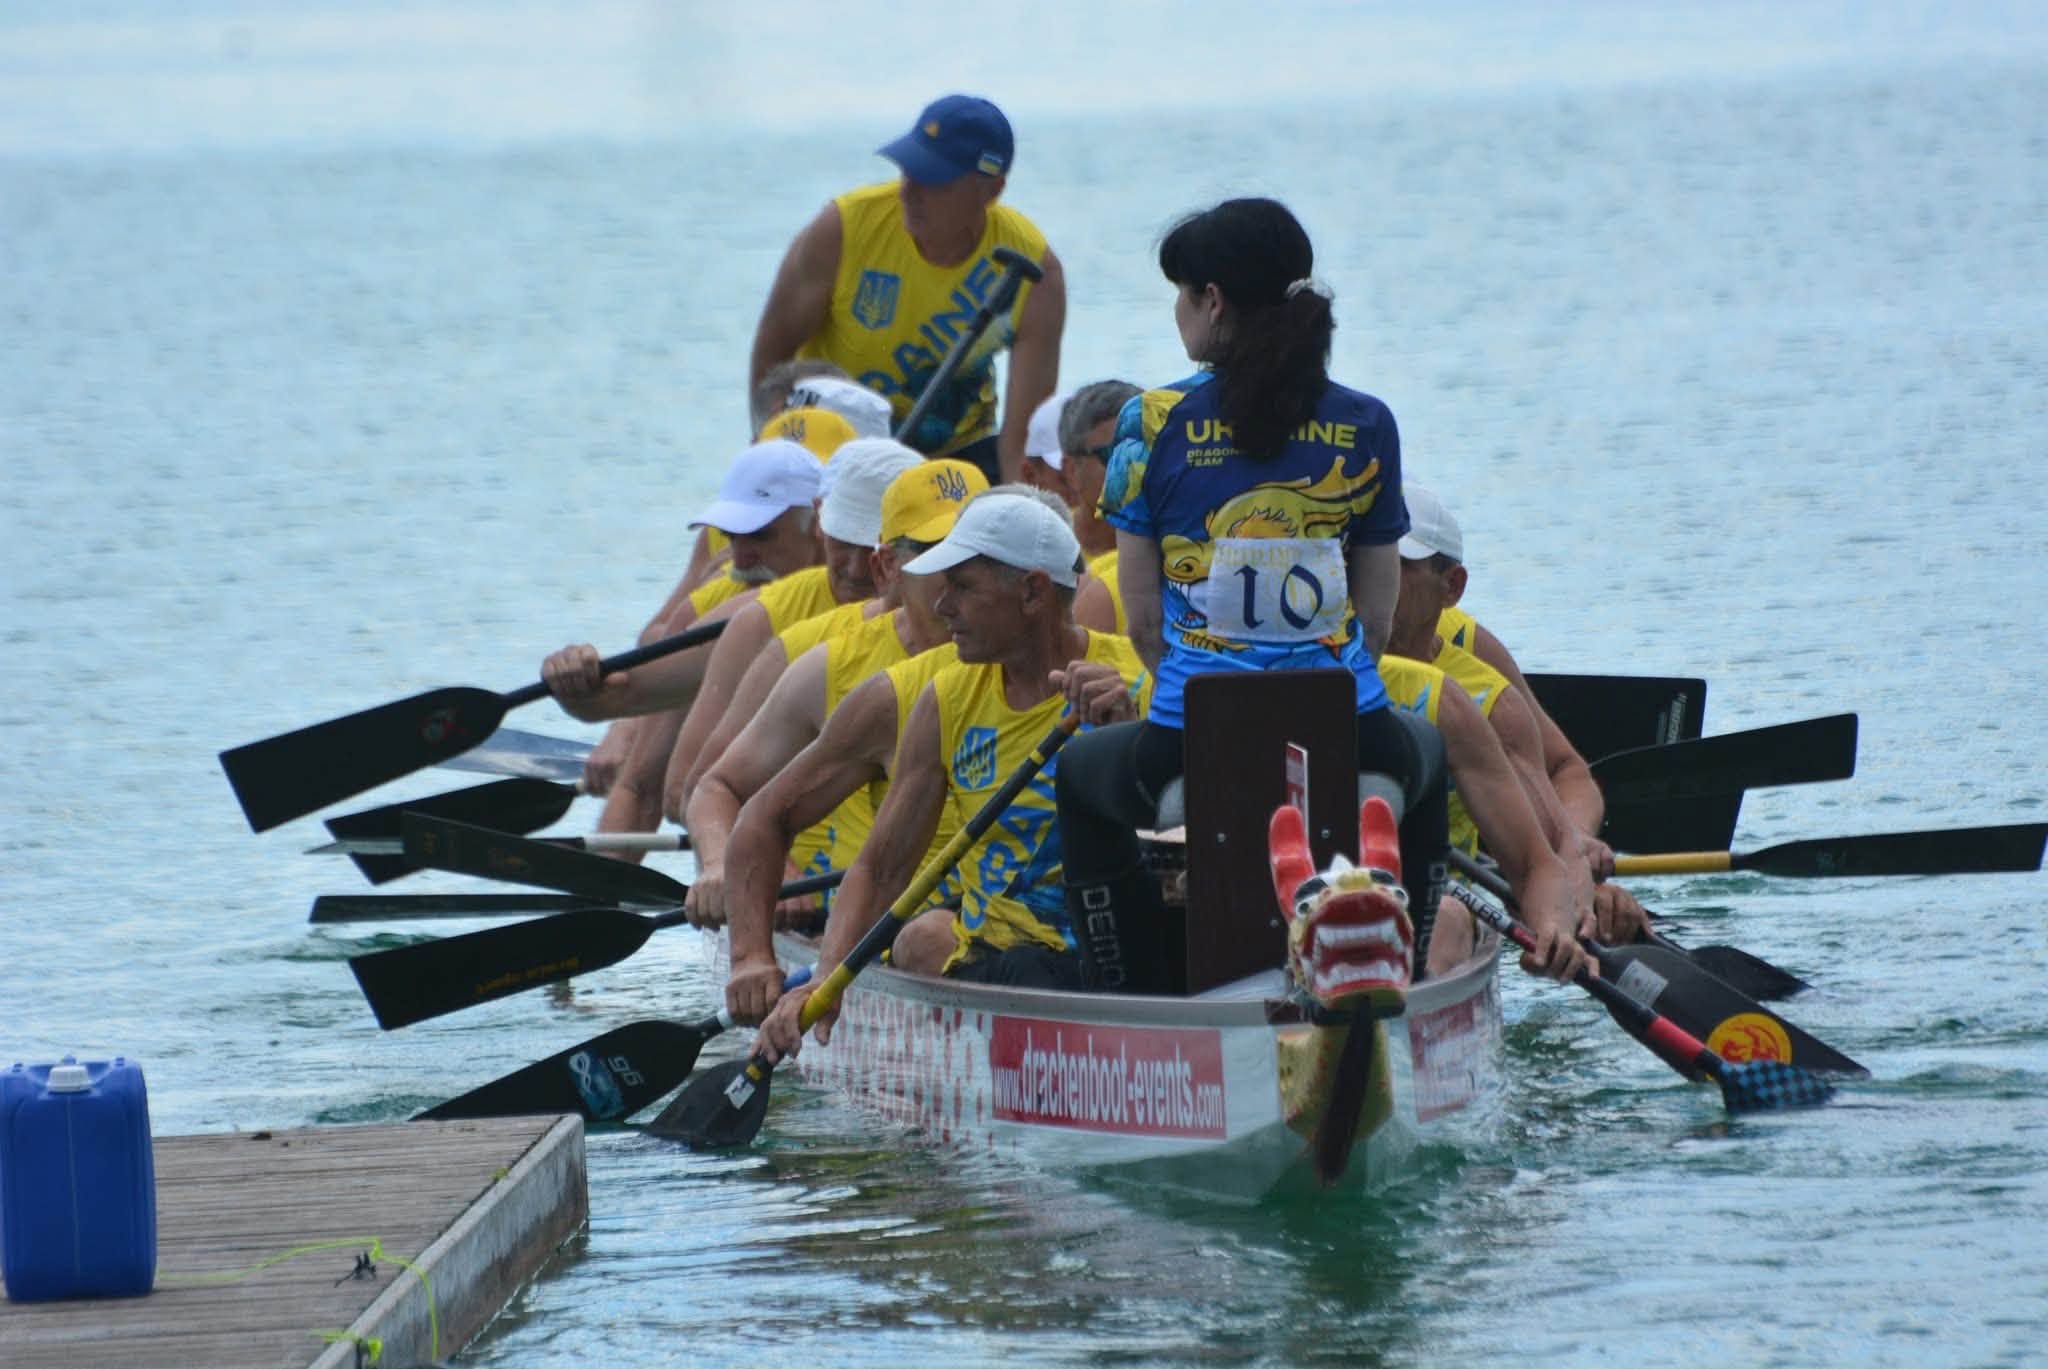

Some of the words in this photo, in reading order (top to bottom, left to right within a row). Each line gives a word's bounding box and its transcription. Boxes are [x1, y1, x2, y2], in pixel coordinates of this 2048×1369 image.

[1185, 418, 1357, 449] UKINE
[1233, 563, 1323, 630] 10
[992, 1026, 1223, 1129] www.drachenboot-events.com
